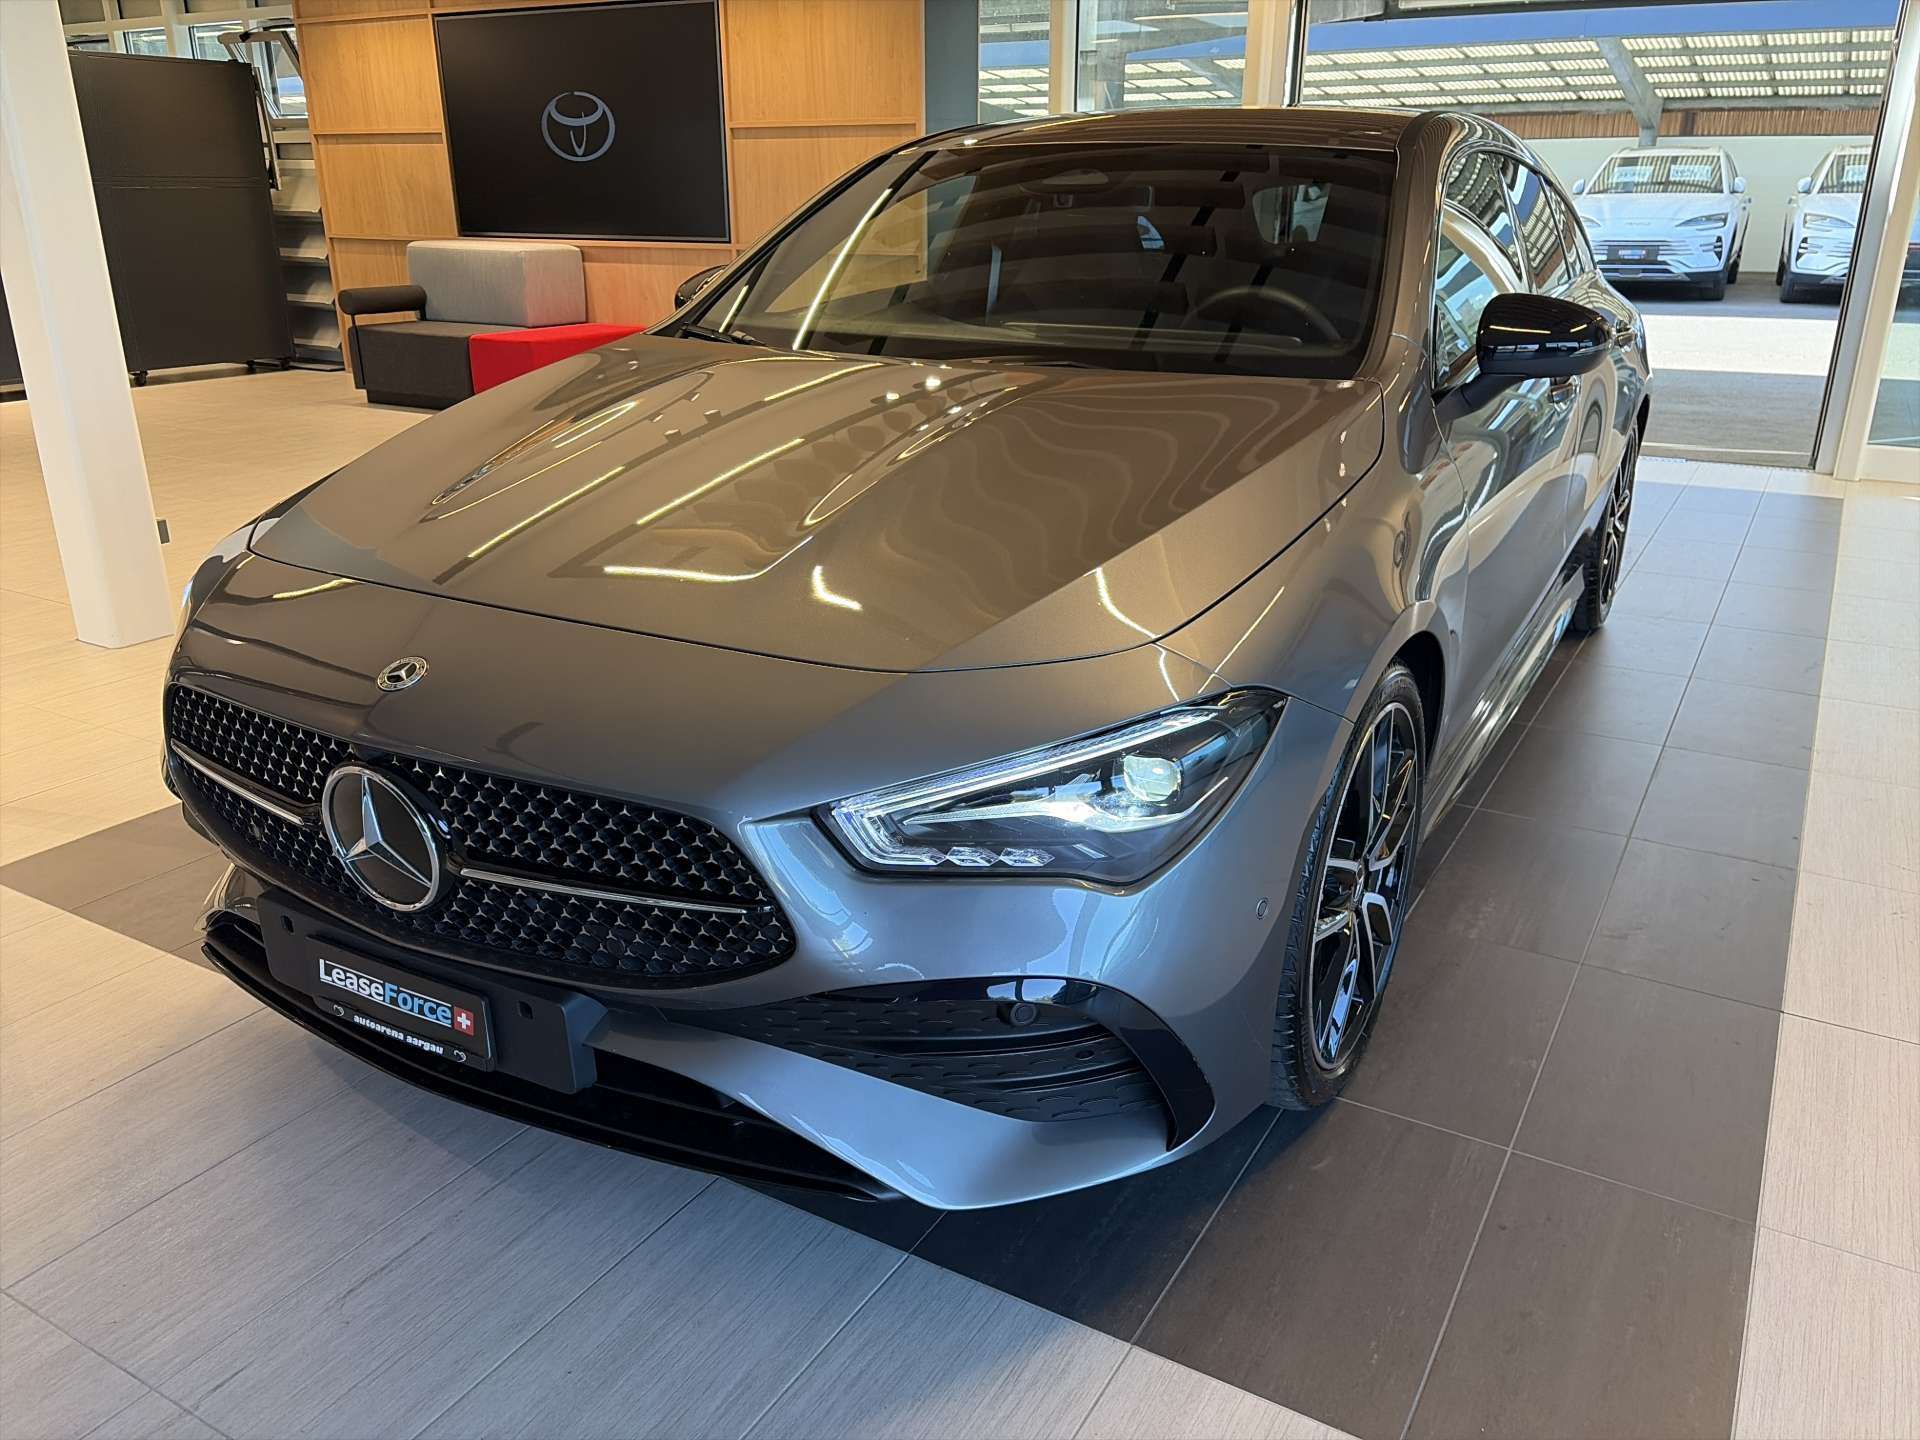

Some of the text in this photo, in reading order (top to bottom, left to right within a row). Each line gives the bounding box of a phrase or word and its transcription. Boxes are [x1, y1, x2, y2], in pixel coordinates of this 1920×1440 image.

[319, 958, 452, 1025] LeaseForce
[353, 1014, 444, 1055] autoarena aargau
